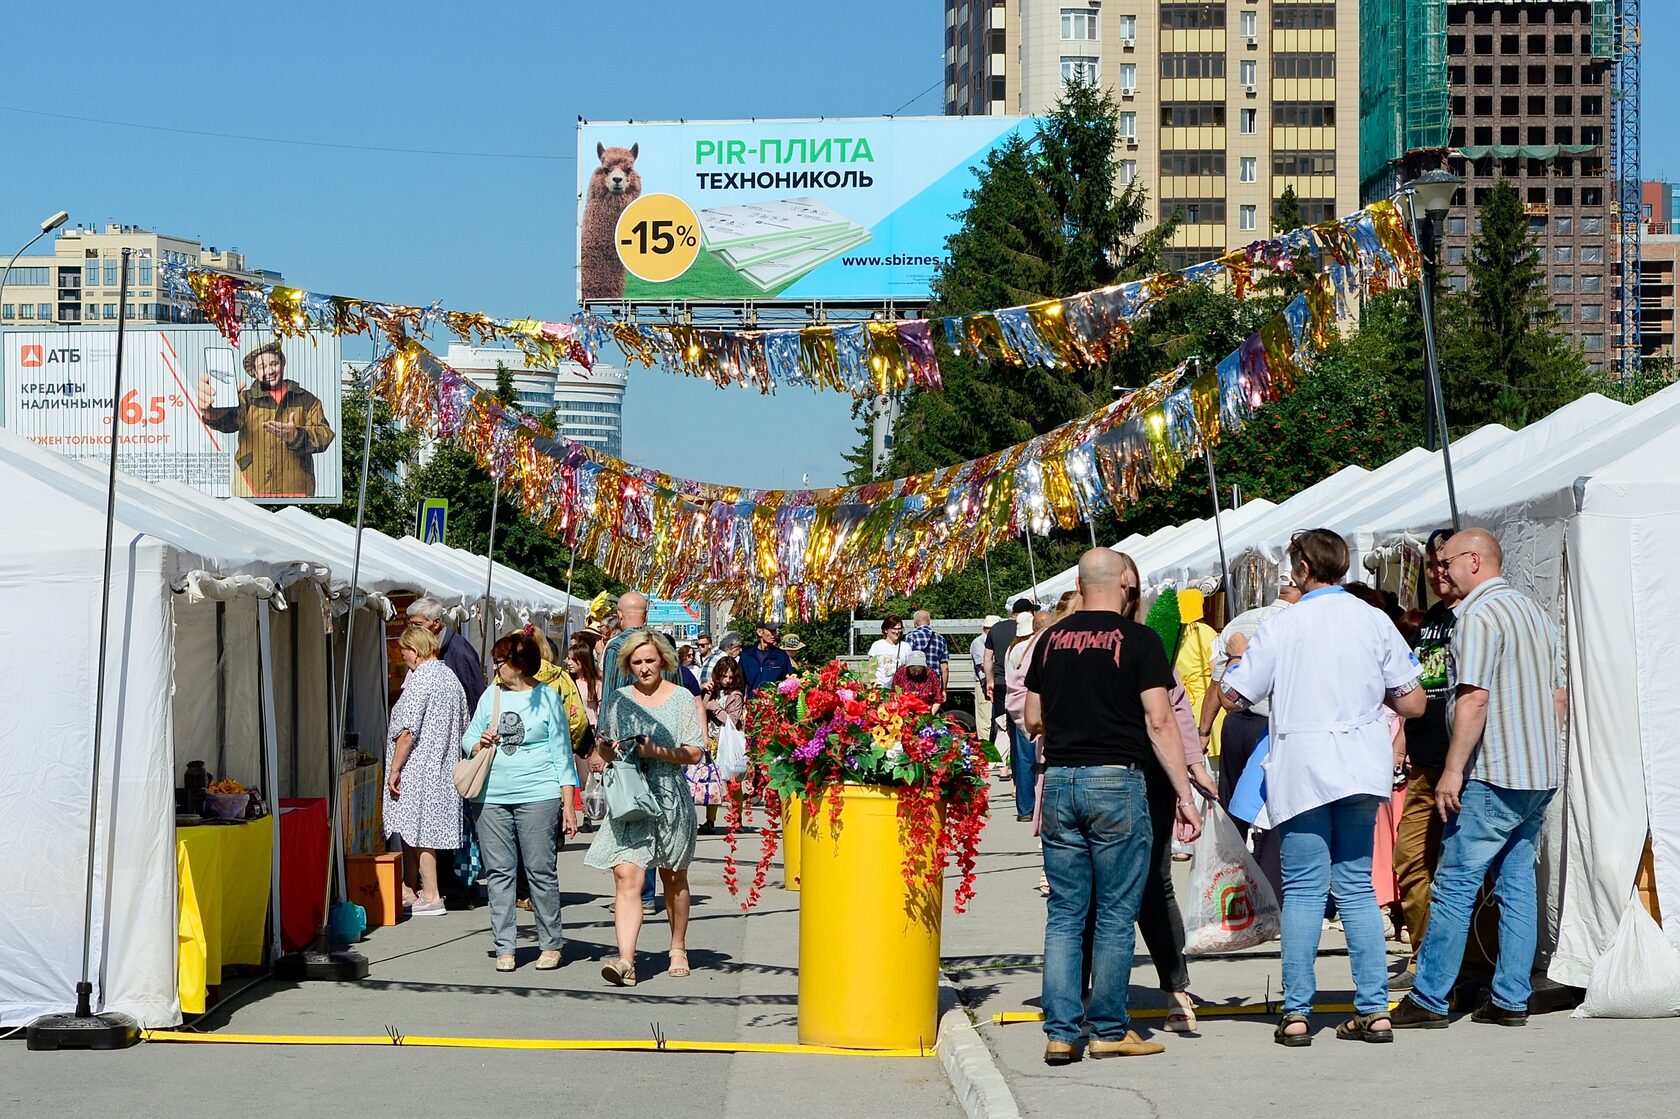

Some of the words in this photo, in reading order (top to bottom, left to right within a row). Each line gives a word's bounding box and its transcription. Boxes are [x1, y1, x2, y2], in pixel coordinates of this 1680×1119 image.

[696, 138, 874, 164] PIR-ПЛИТА
[696, 171, 874, 190] ТЕХНОНИКОЛЬ
[621, 220, 697, 254] -15%
[47, 349, 81, 363] АТБ
[21, 383, 86, 395] КРЕДИТЫ
[21, 399, 114, 410] НАЛИЧНЫМИ
[65, 435, 112, 445] ТОЛЬКО
[1043, 628, 1125, 668] MANOWAR
